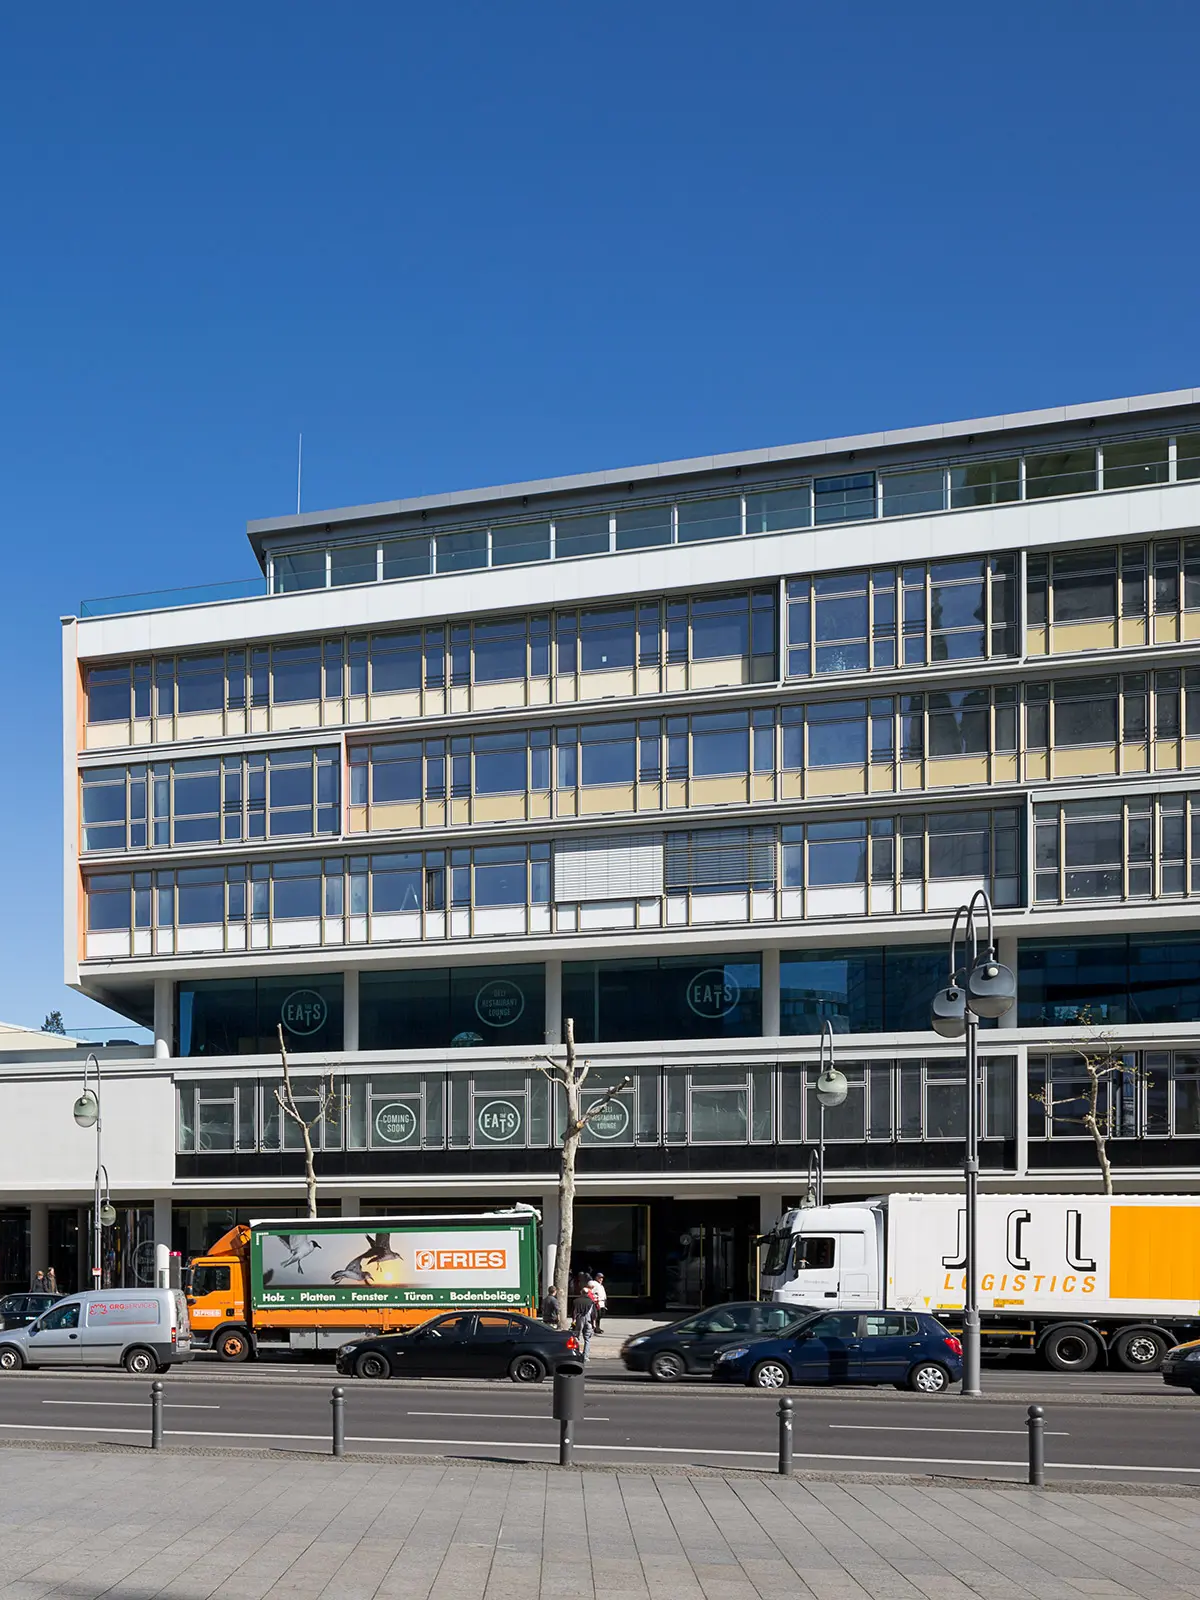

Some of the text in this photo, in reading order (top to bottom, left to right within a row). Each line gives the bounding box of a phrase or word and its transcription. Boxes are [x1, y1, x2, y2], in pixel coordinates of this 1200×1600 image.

[694, 984, 733, 1009] EATS
[288, 1004, 321, 1027] EATS
[382, 1114, 410, 1123] COMING
[484, 1113, 515, 1133] EATS
[387, 1124, 406, 1133] SOON
[942, 1208, 1097, 1272] JCL
[439, 1252, 505, 1268] FRIES
[262, 1291, 521, 1302] Holz Platten Fenster Türen Bodenbeläge
